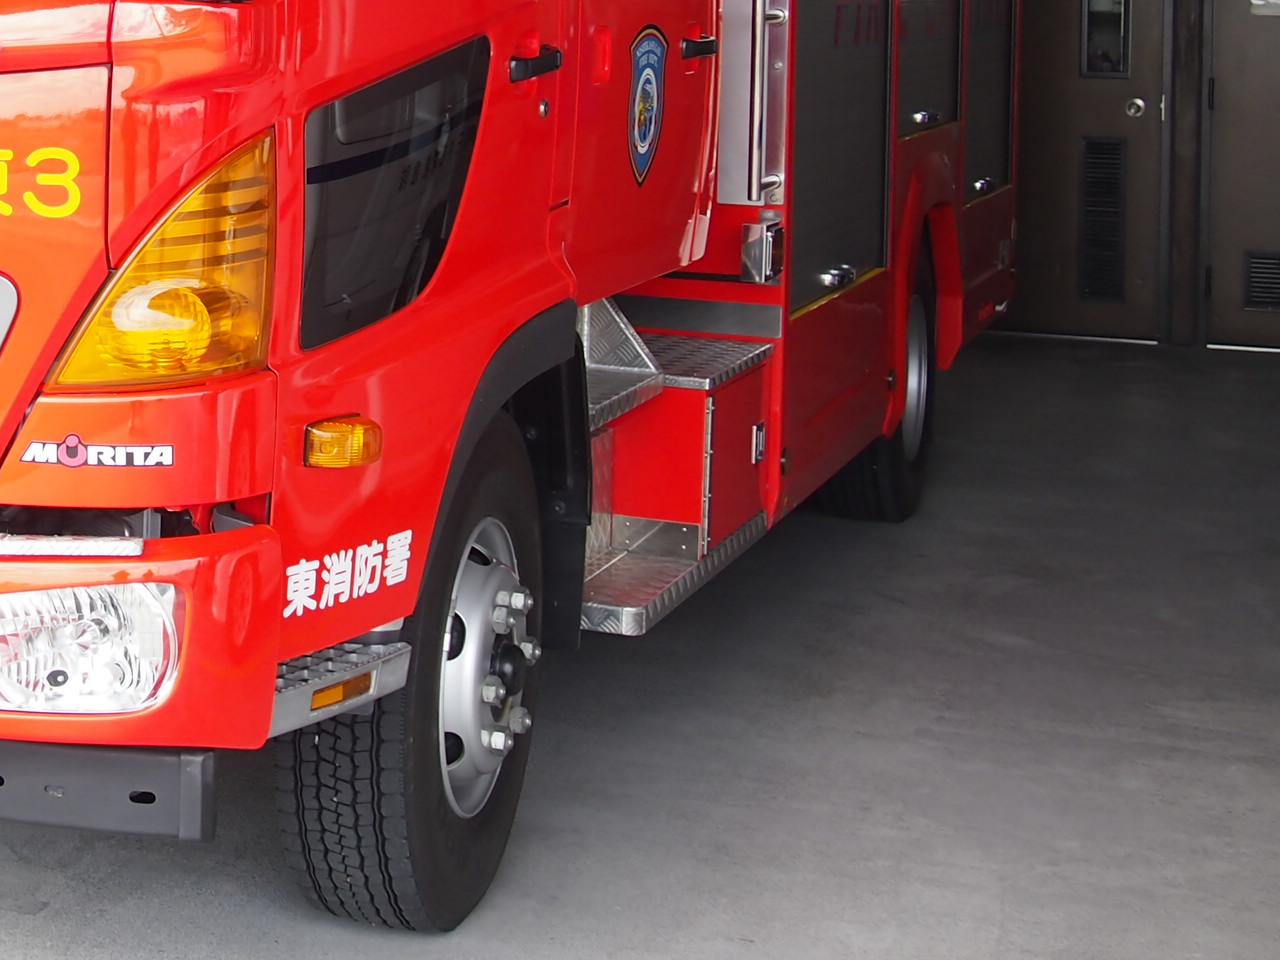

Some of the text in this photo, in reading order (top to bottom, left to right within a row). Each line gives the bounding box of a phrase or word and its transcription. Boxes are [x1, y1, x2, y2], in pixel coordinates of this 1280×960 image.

[22, 433, 173, 467] MORITA
[282, 528, 413, 620] 東消防署
